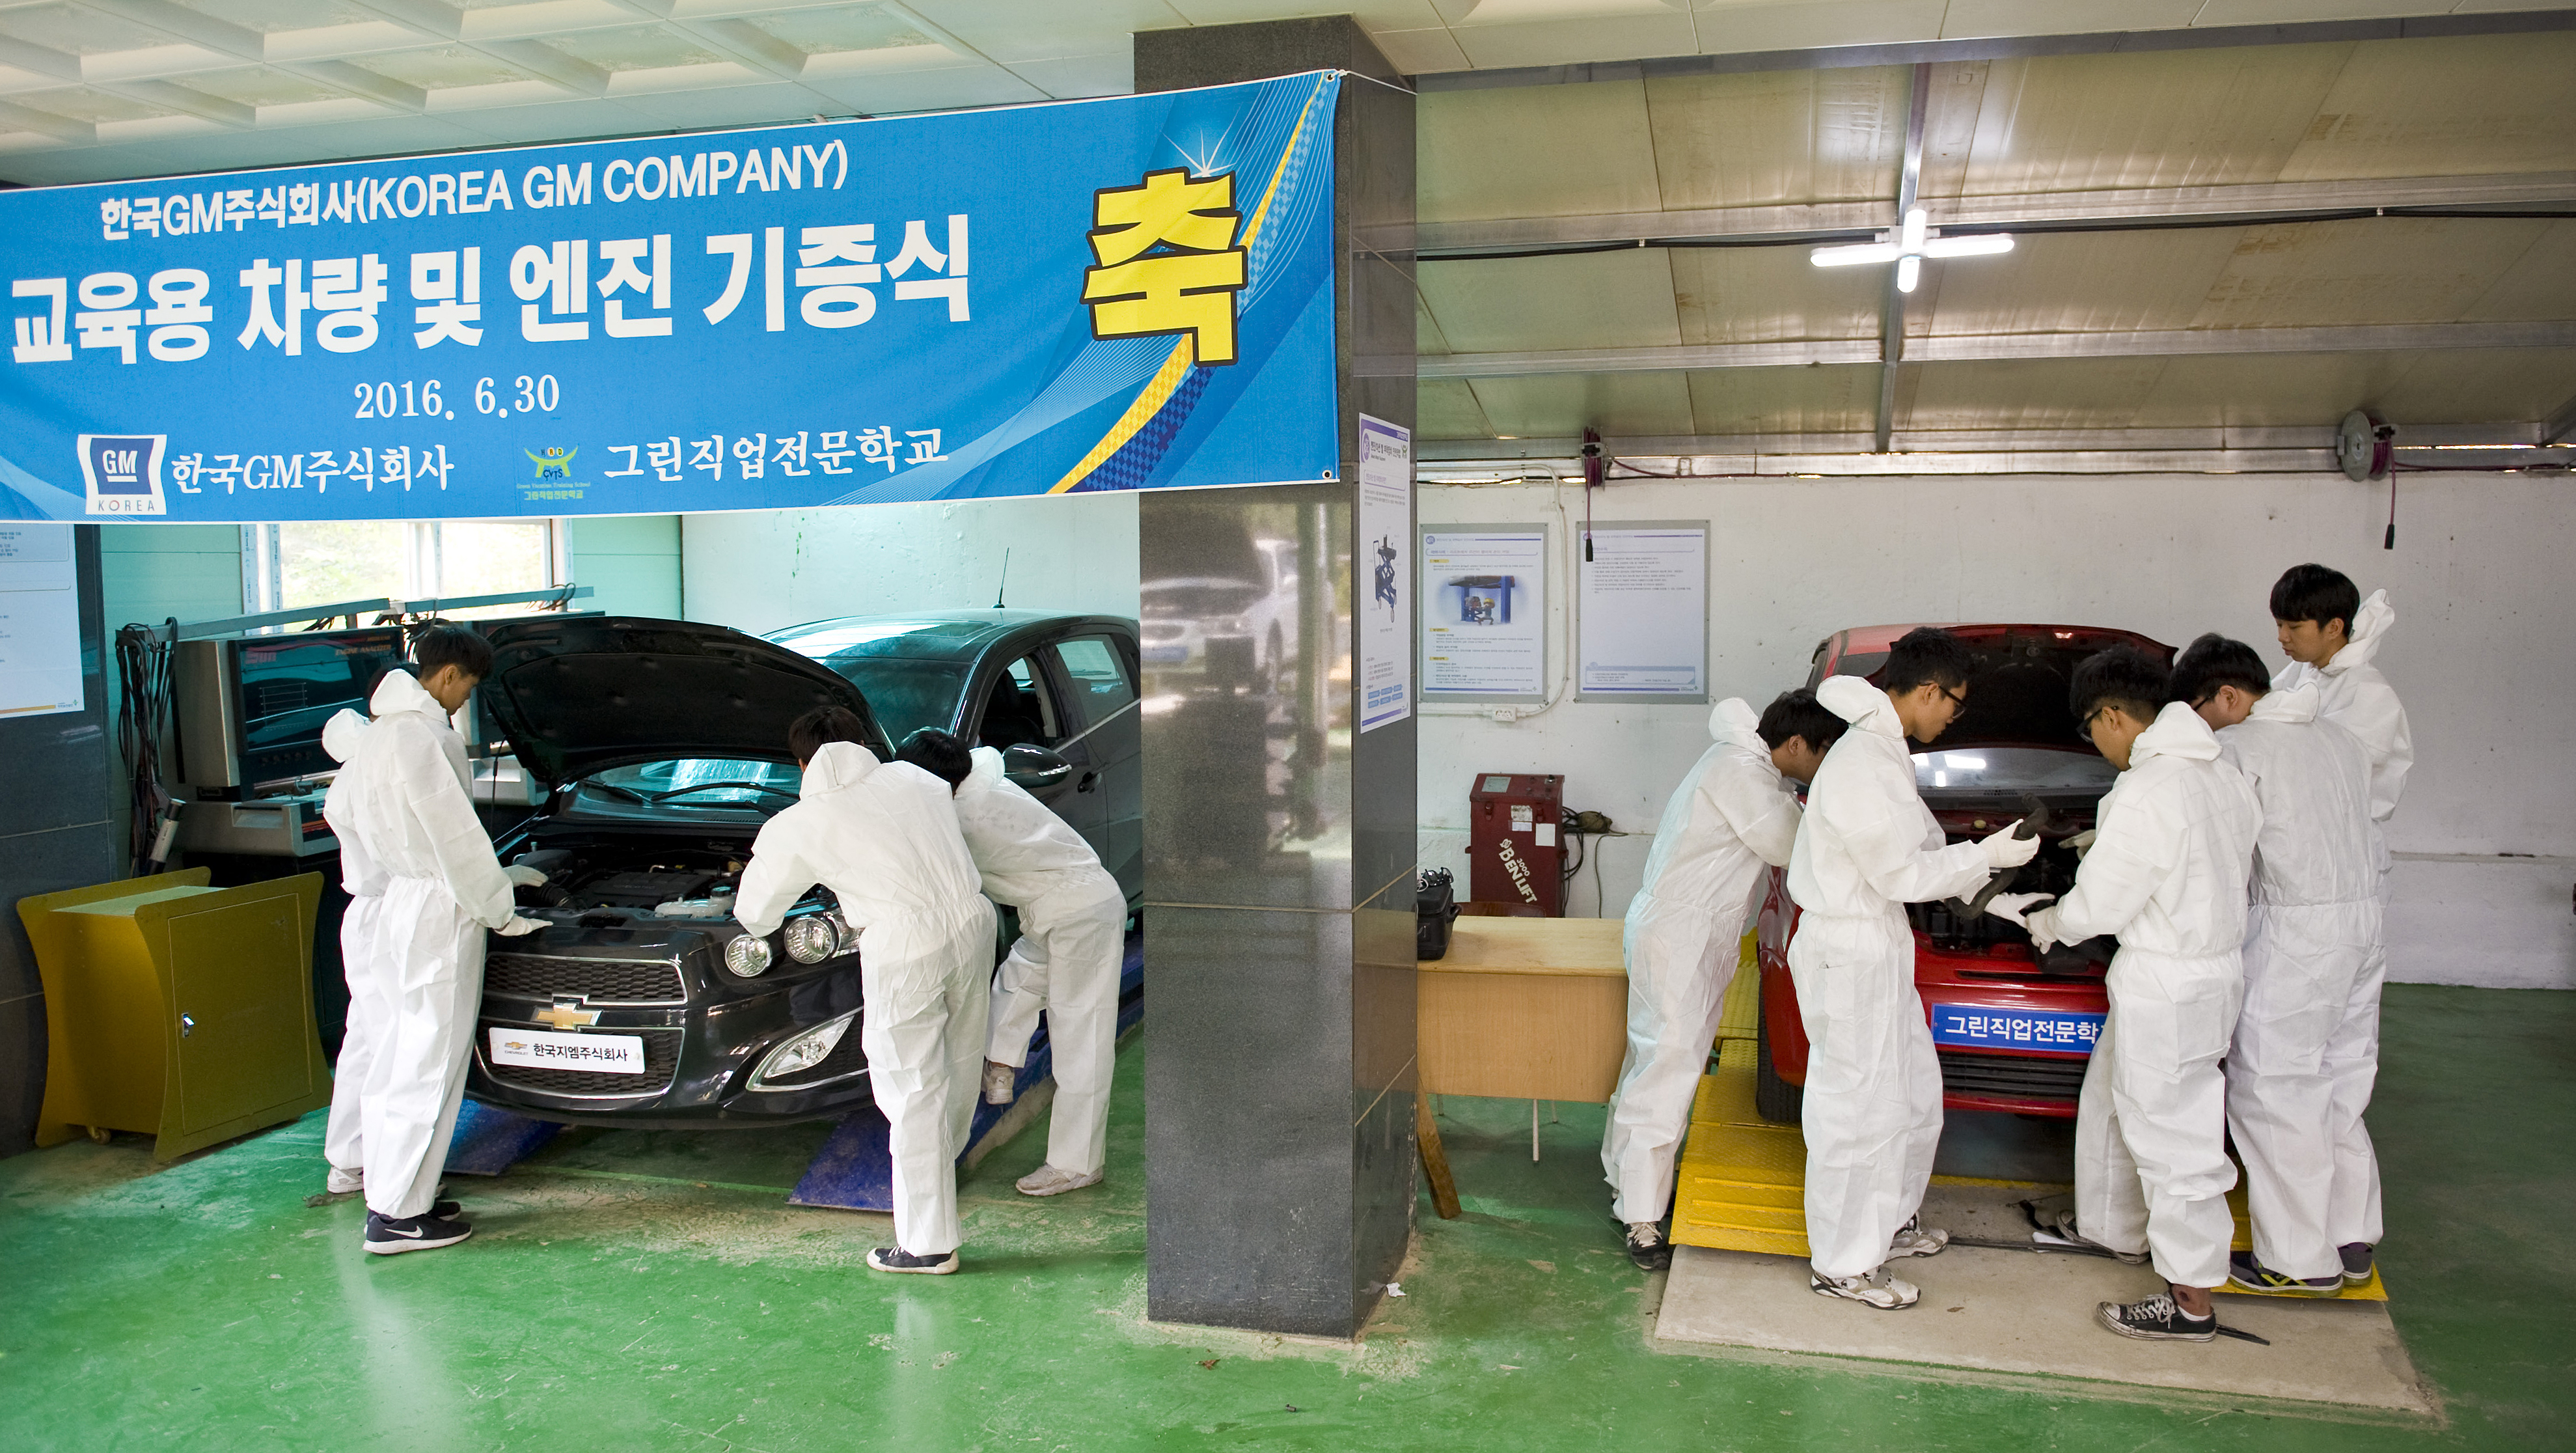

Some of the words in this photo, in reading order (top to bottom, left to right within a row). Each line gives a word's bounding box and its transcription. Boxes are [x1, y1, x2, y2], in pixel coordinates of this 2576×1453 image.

[523, 162, 592, 209] GM
[603, 139, 848, 202] COMPANY)
[12, 268, 213, 365] 교육용
[237, 253, 388, 356] 차량
[410, 246, 484, 350] 및
[510, 234, 672, 342] 엔진
[702, 214, 970, 333] 기증식
[1081, 168, 1248, 366] 축
[354, 380, 454, 421] 2016.
[475, 374, 560, 419] 6.30
[102, 450, 139, 474] GM
[171, 444, 455, 495] 한국GM주식회사
[603, 424, 949, 482] 그린직업전문학교
[98, 499, 155, 512] KOREA
[1516, 858, 1530, 877] 3000
[533, 1043, 628, 1062] 한국지엠주식회사
[1945, 1016, 2104, 1044] 그린직업전문학
